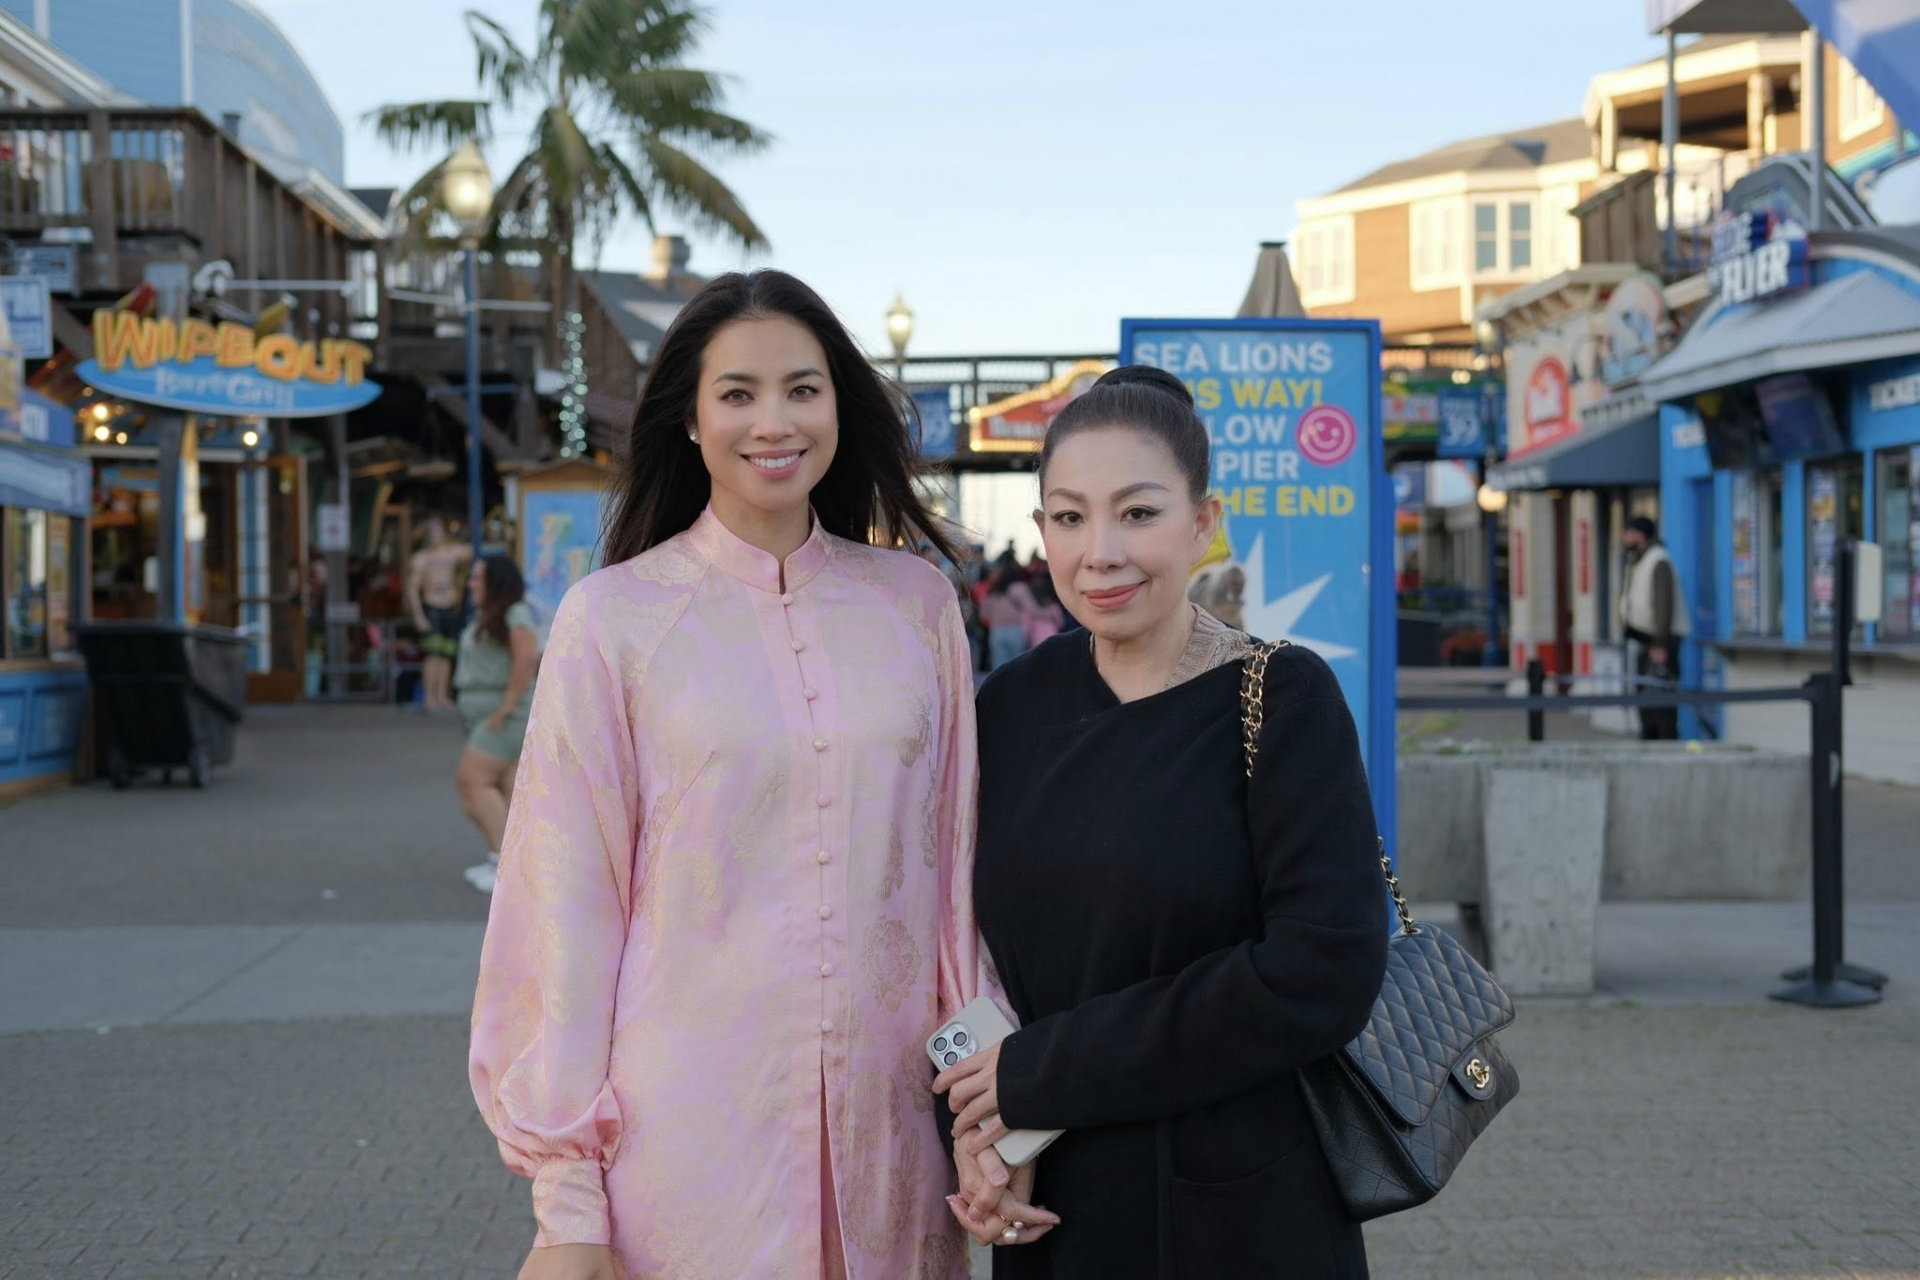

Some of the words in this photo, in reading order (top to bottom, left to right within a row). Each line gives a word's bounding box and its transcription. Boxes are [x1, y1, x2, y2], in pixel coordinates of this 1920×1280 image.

[1721, 240, 1790, 304] FLYER
[93, 309, 371, 385] WIPEOUT
[1135, 343, 1209, 373] SEA
[1220, 341, 1333, 374] LIONS
[1230, 378, 1324, 407] WAY!
[1440, 413, 1480, 447] 39
[1216, 450, 1299, 481] PIER
[1209, 485, 1267, 516] HE
[1277, 485, 1355, 516] END
